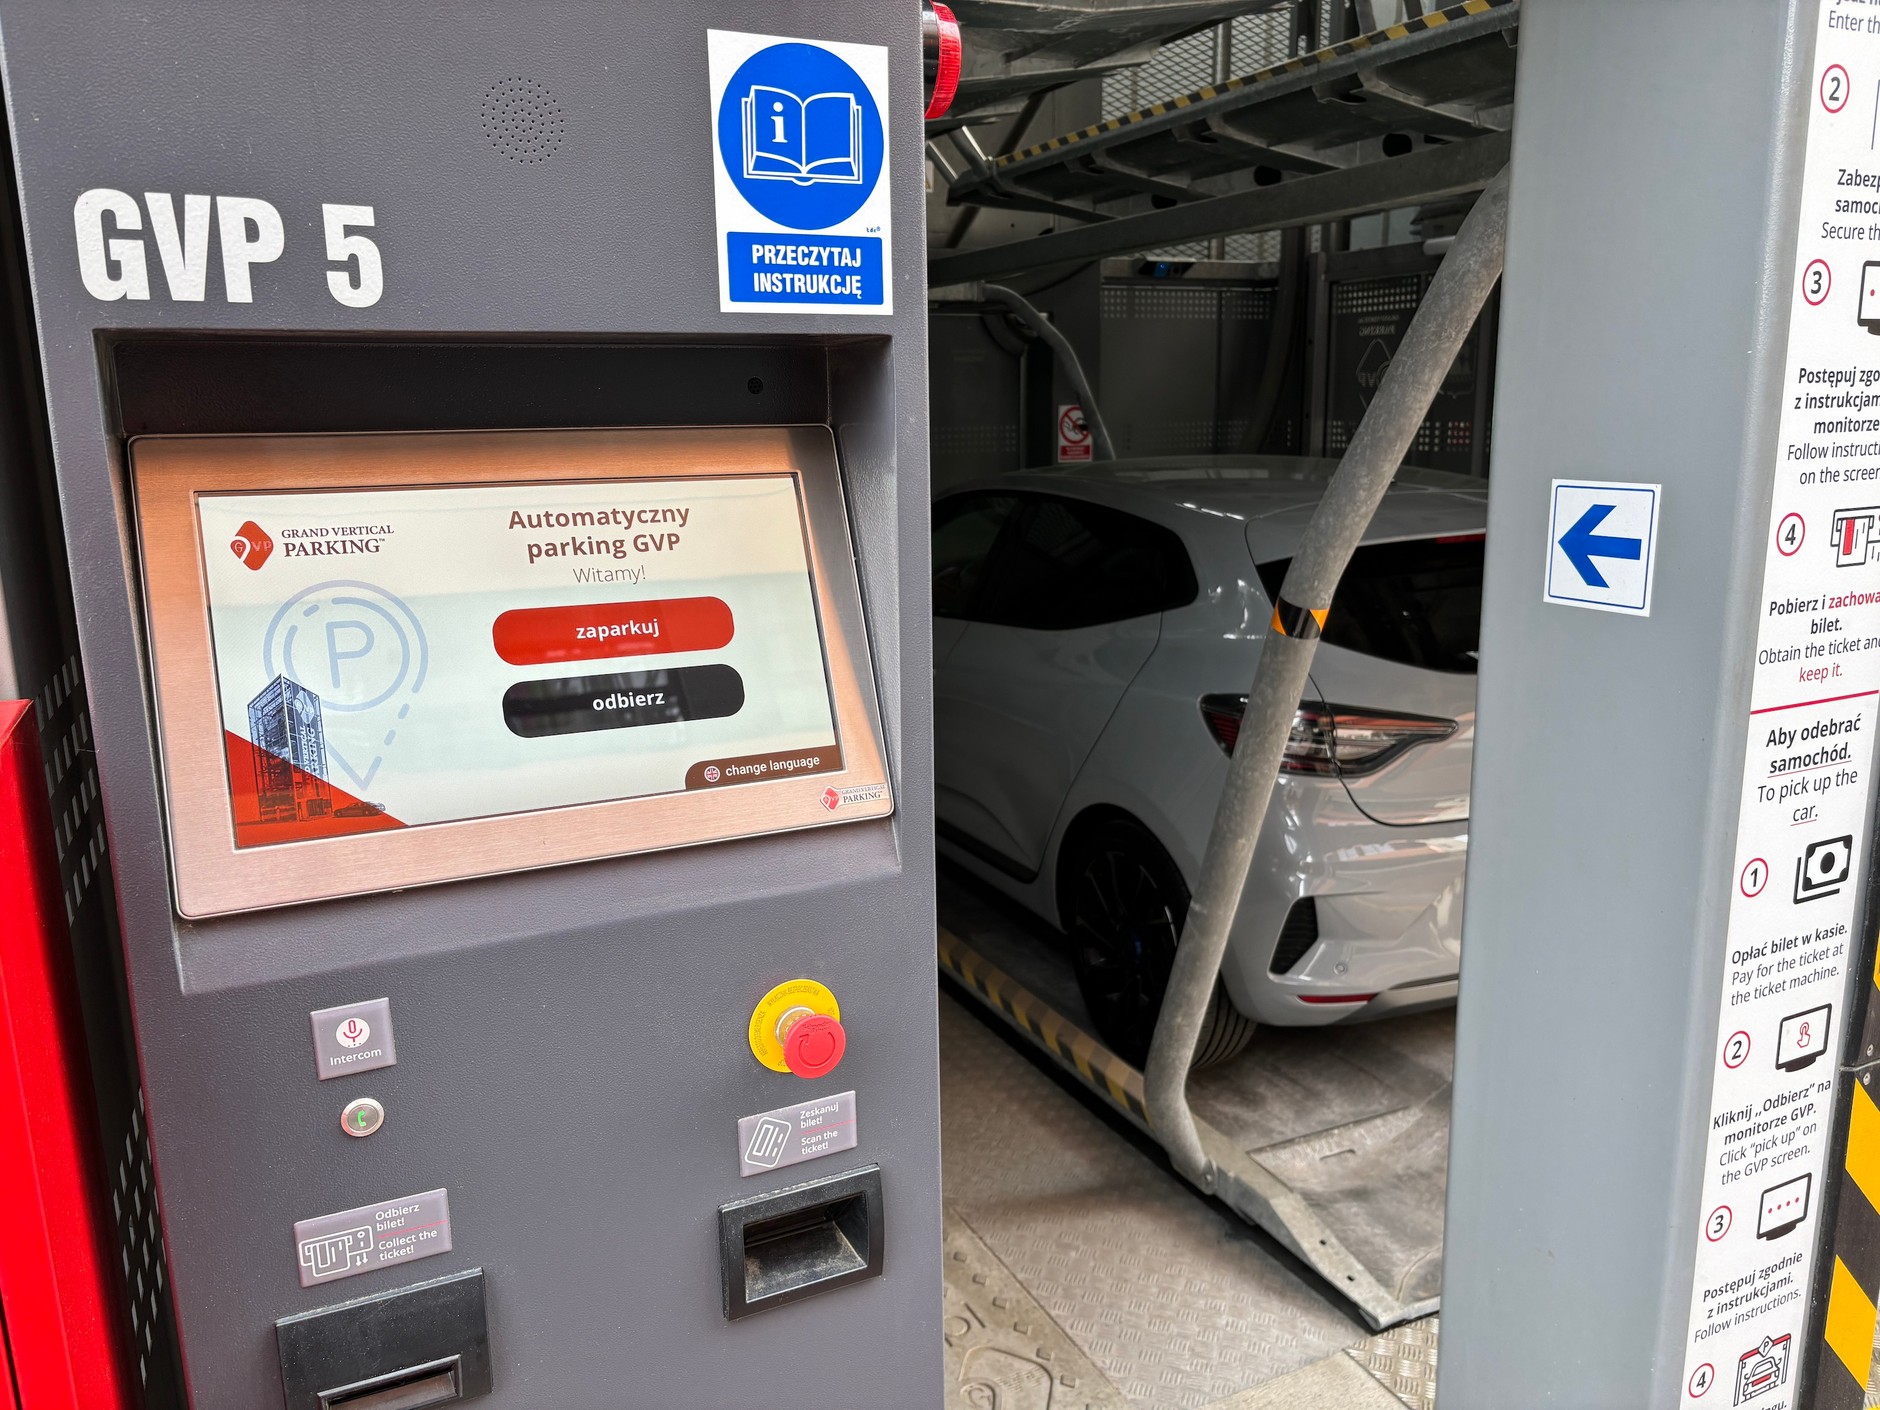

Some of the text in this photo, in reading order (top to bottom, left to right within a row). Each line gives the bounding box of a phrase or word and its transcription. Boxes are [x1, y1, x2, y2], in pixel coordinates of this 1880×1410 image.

[1829, 10, 1864, 32] Enter
[1829, 76, 1841, 102] 2
[1835, 199, 1880, 214] samoc
[1821, 222, 1864, 240] Secure
[74, 188, 384, 308] GVP 5
[752, 244, 862, 268] PRZECZYTAJ
[754, 272, 862, 299] INSTRUKCJĘ
[1810, 270, 1822, 294] 3
[1798, 366, 1880, 388] Postępuj zgo
[1794, 397, 1802, 410] z
[1814, 416, 1880, 434] monitorze
[1788, 443, 1829, 460] Follow
[1800, 471, 1816, 484] on
[1820, 466, 1840, 484] the
[508, 506, 690, 530] Automatyczny
[281, 524, 394, 539] GRAND VERTICAL
[1784, 524, 1796, 546] 4
[527, 532, 681, 564] parking GVP
[572, 565, 646, 585] Witamy!
[1769, 598, 1818, 616] Pobierz
[1822, 594, 1826, 610] i
[576, 618, 660, 642] zaparkuj
[1810, 617, 1842, 634] bilet.
[1758, 646, 1801, 665] Obtain
[1805, 642, 1825, 658] the
[1828, 638, 1862, 655] ticket
[1799, 662, 1842, 684] keep it.
[592, 690, 665, 712] odbierz
[1766, 713, 1862, 748] Aby odebrać
[725, 756, 820, 779] change language
[1770, 742, 1852, 774] samochód.
[1758, 769, 1858, 804] To pick up the
[1792, 805, 1818, 822] car.
[1750, 868, 1758, 888] 1
[1732, 922, 1848, 966] Opłać bilet w kasie.
[1732, 942, 1844, 986] Pay for the ticket at
[1731, 964, 1840, 1006] the ticket machine.
[330, 1047, 382, 1066] Intercom
[1732, 1040, 1742, 1060] 2
[800, 1102, 839, 1118] Zeskanuj
[1712, 1104, 1754, 1130] Kliknij
[1817, 1080, 1831, 1093] na
[800, 1117, 823, 1128] bilet!
[1724, 1103, 1816, 1146] monitorze GVP.
[801, 1130, 838, 1146] Scan the
[802, 1142, 828, 1154] ticket!
[1720, 1146, 1747, 1167] Click
[1803, 1122, 1817, 1137] on
[1721, 1144, 1810, 1186] the GVP screen.
[376, 1204, 420, 1220] Odbierz
[376, 1217, 406, 1232] bilet!
[1714, 1214, 1724, 1234] 3
[378, 1229, 438, 1250] Collect the
[379, 1245, 414, 1262] ticket!
[1703, 1252, 1803, 1302] Postępuj zgodnie
[1707, 1273, 1794, 1320] z instrukcjami.
[1694, 1286, 1802, 1344] Follow instructions.
[1696, 1371, 1706, 1388] 4
